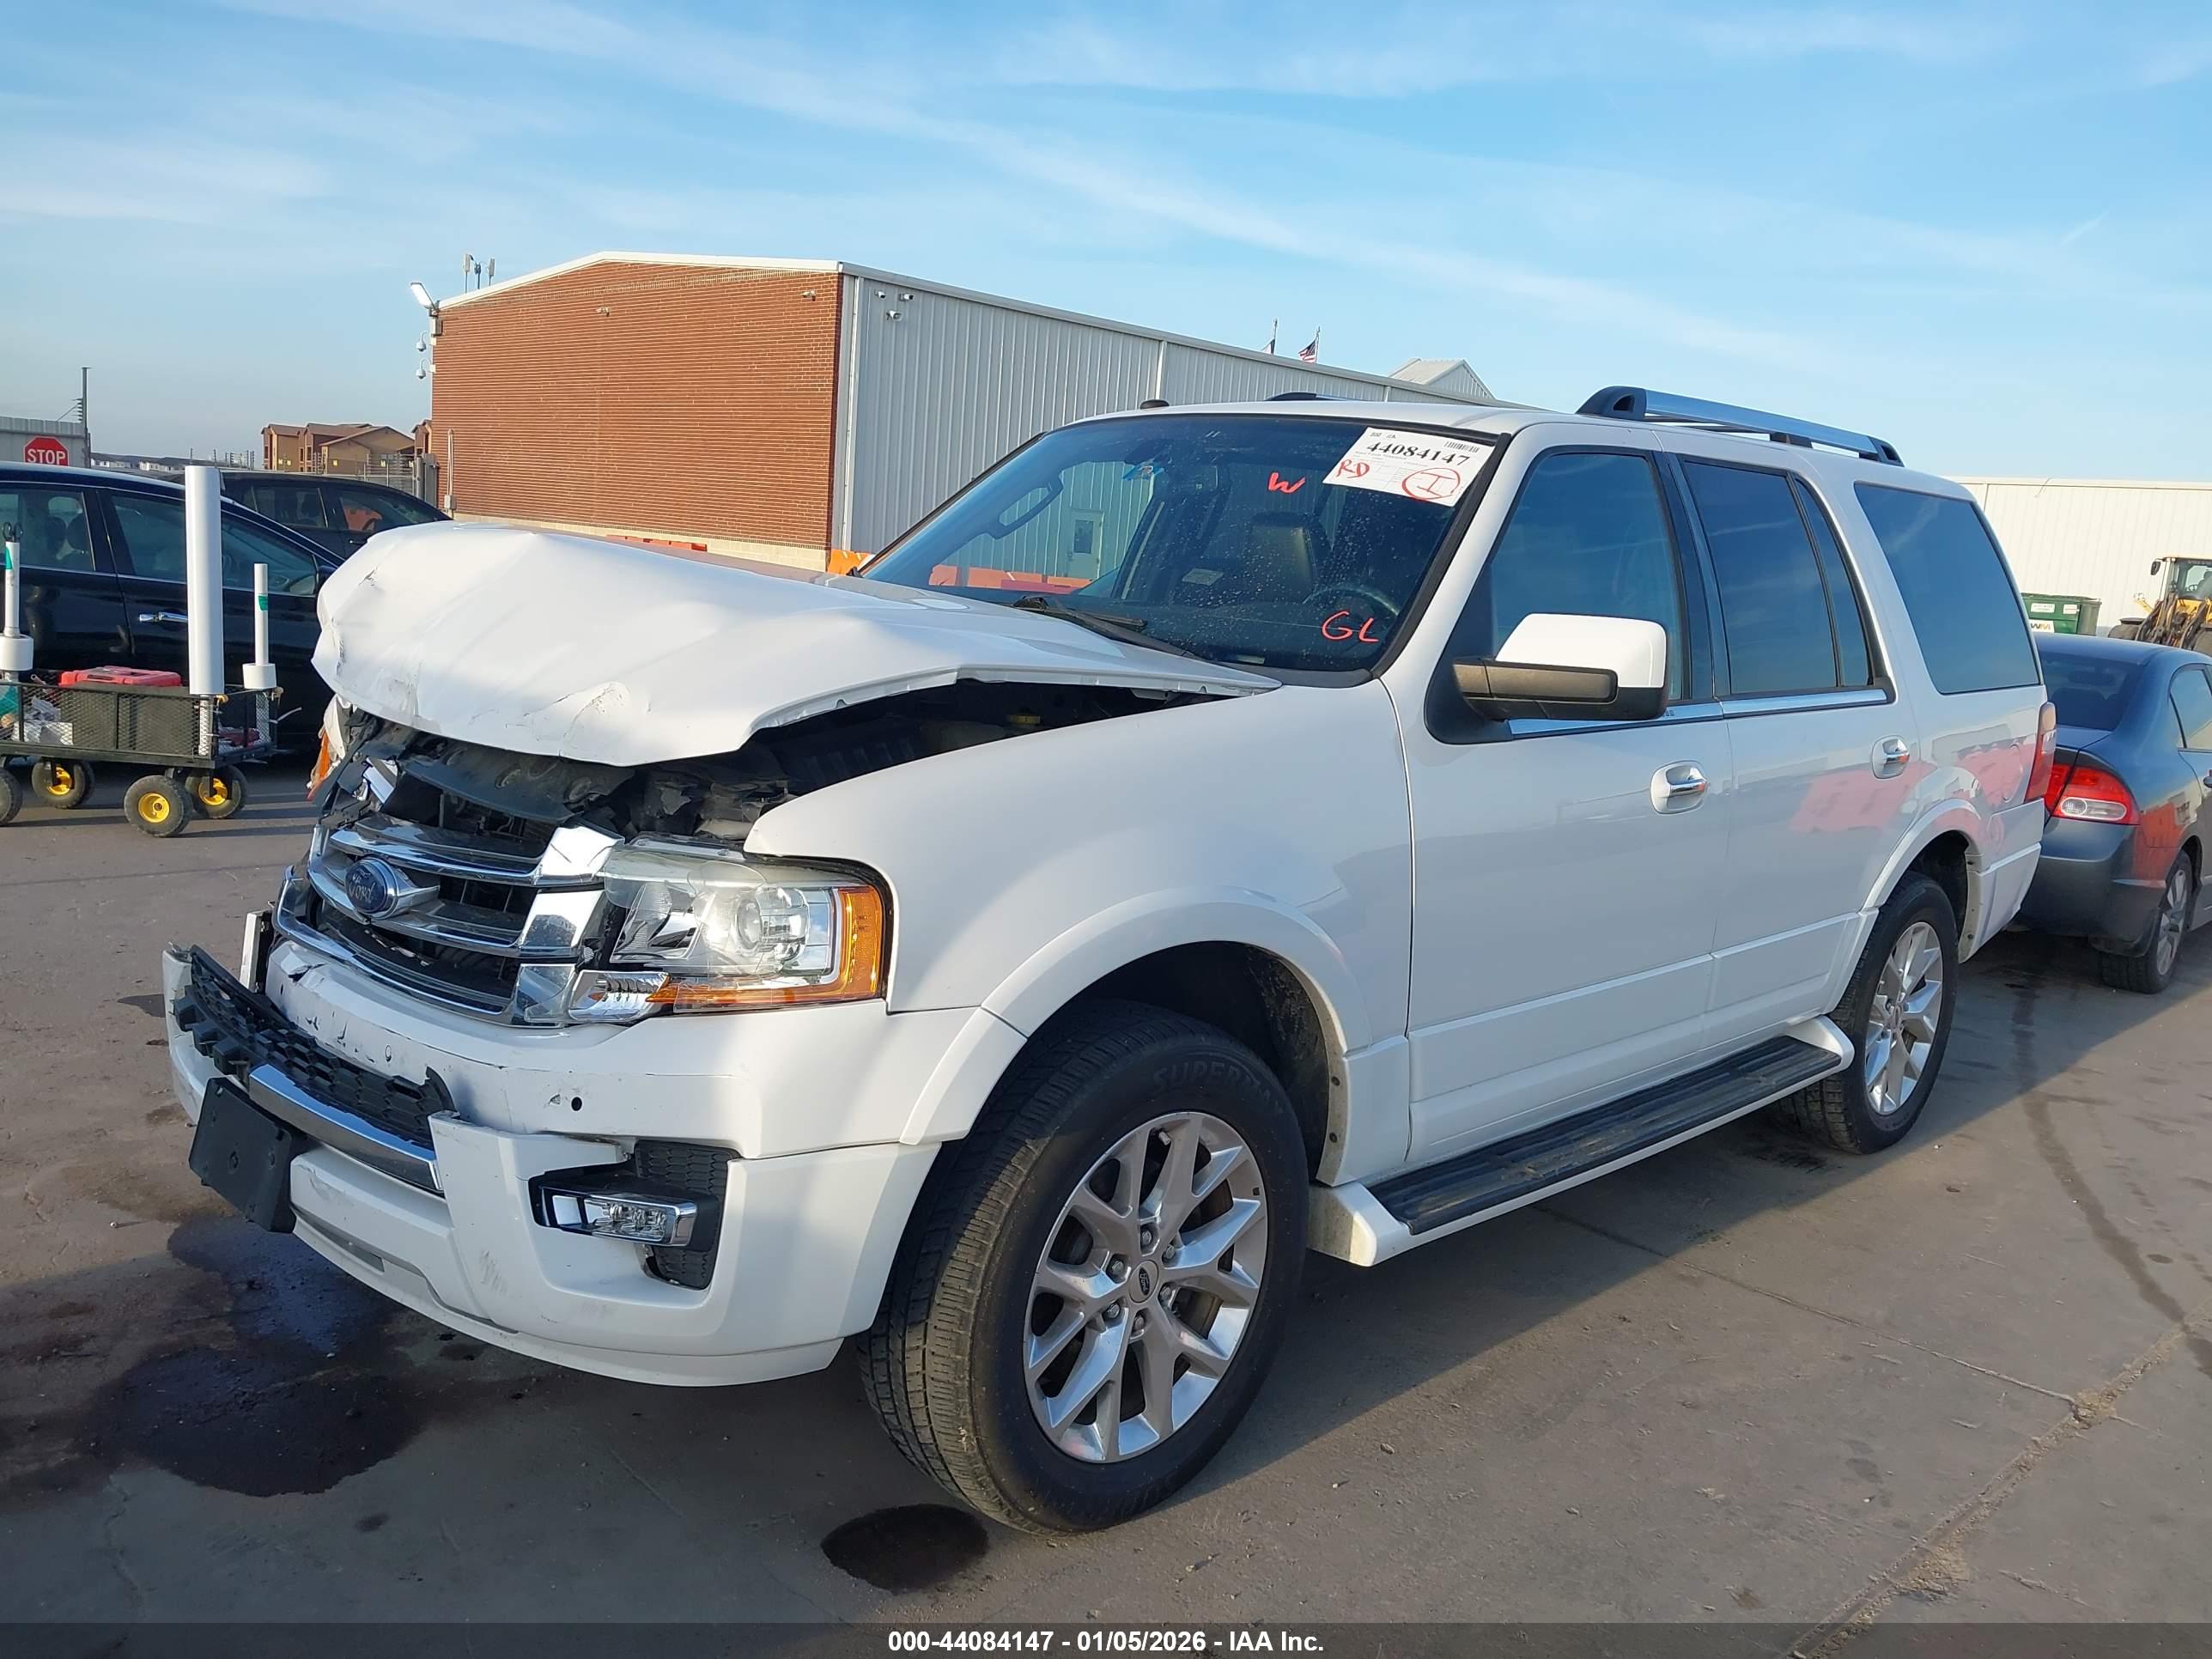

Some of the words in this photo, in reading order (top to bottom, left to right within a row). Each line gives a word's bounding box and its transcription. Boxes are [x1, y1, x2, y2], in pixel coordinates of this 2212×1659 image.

[27, 448, 66, 465] STOP
[1367, 441, 1471, 466] 44084147
[1336, 459, 1370, 479] RD
[1322, 611, 1379, 642] GL
[349, 867, 376, 904] Ford
